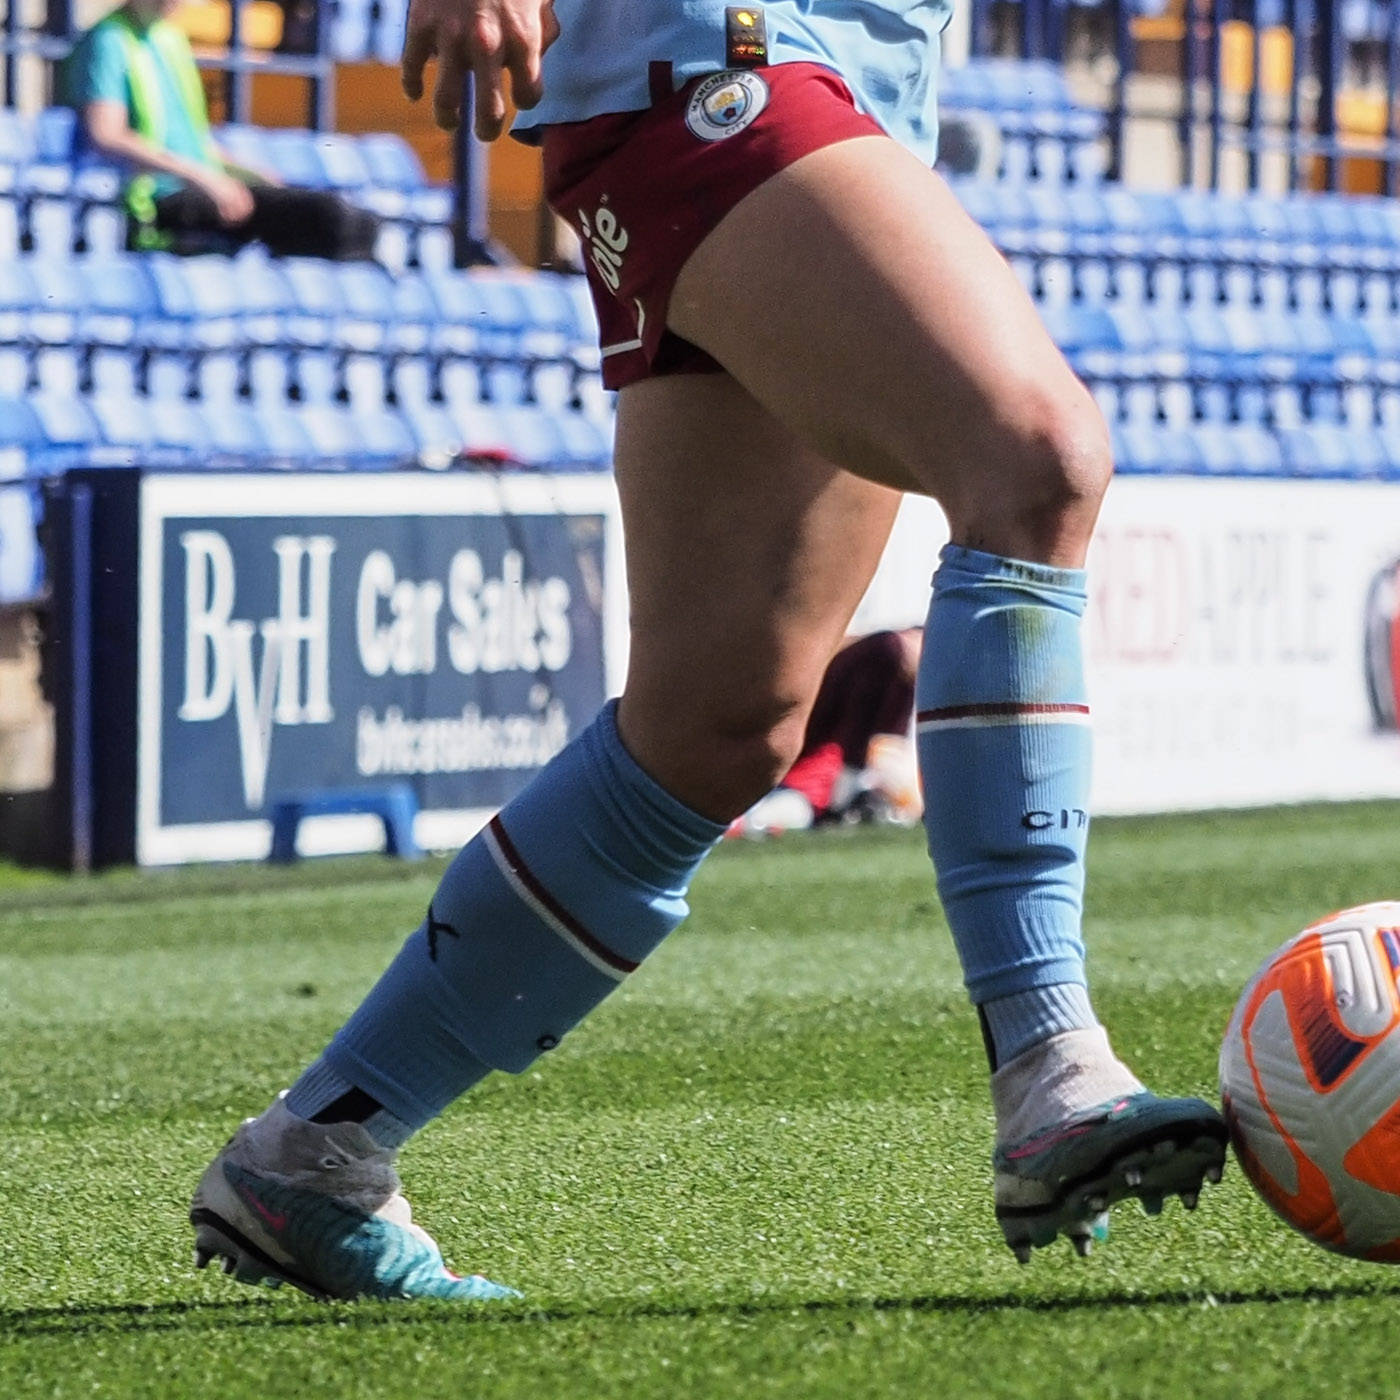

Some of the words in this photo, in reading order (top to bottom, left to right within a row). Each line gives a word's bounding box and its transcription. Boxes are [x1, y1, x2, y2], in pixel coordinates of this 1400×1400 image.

[356, 550, 442, 677] Car
[448, 547, 572, 674] Sales
[1021, 808, 1086, 831] CIT
